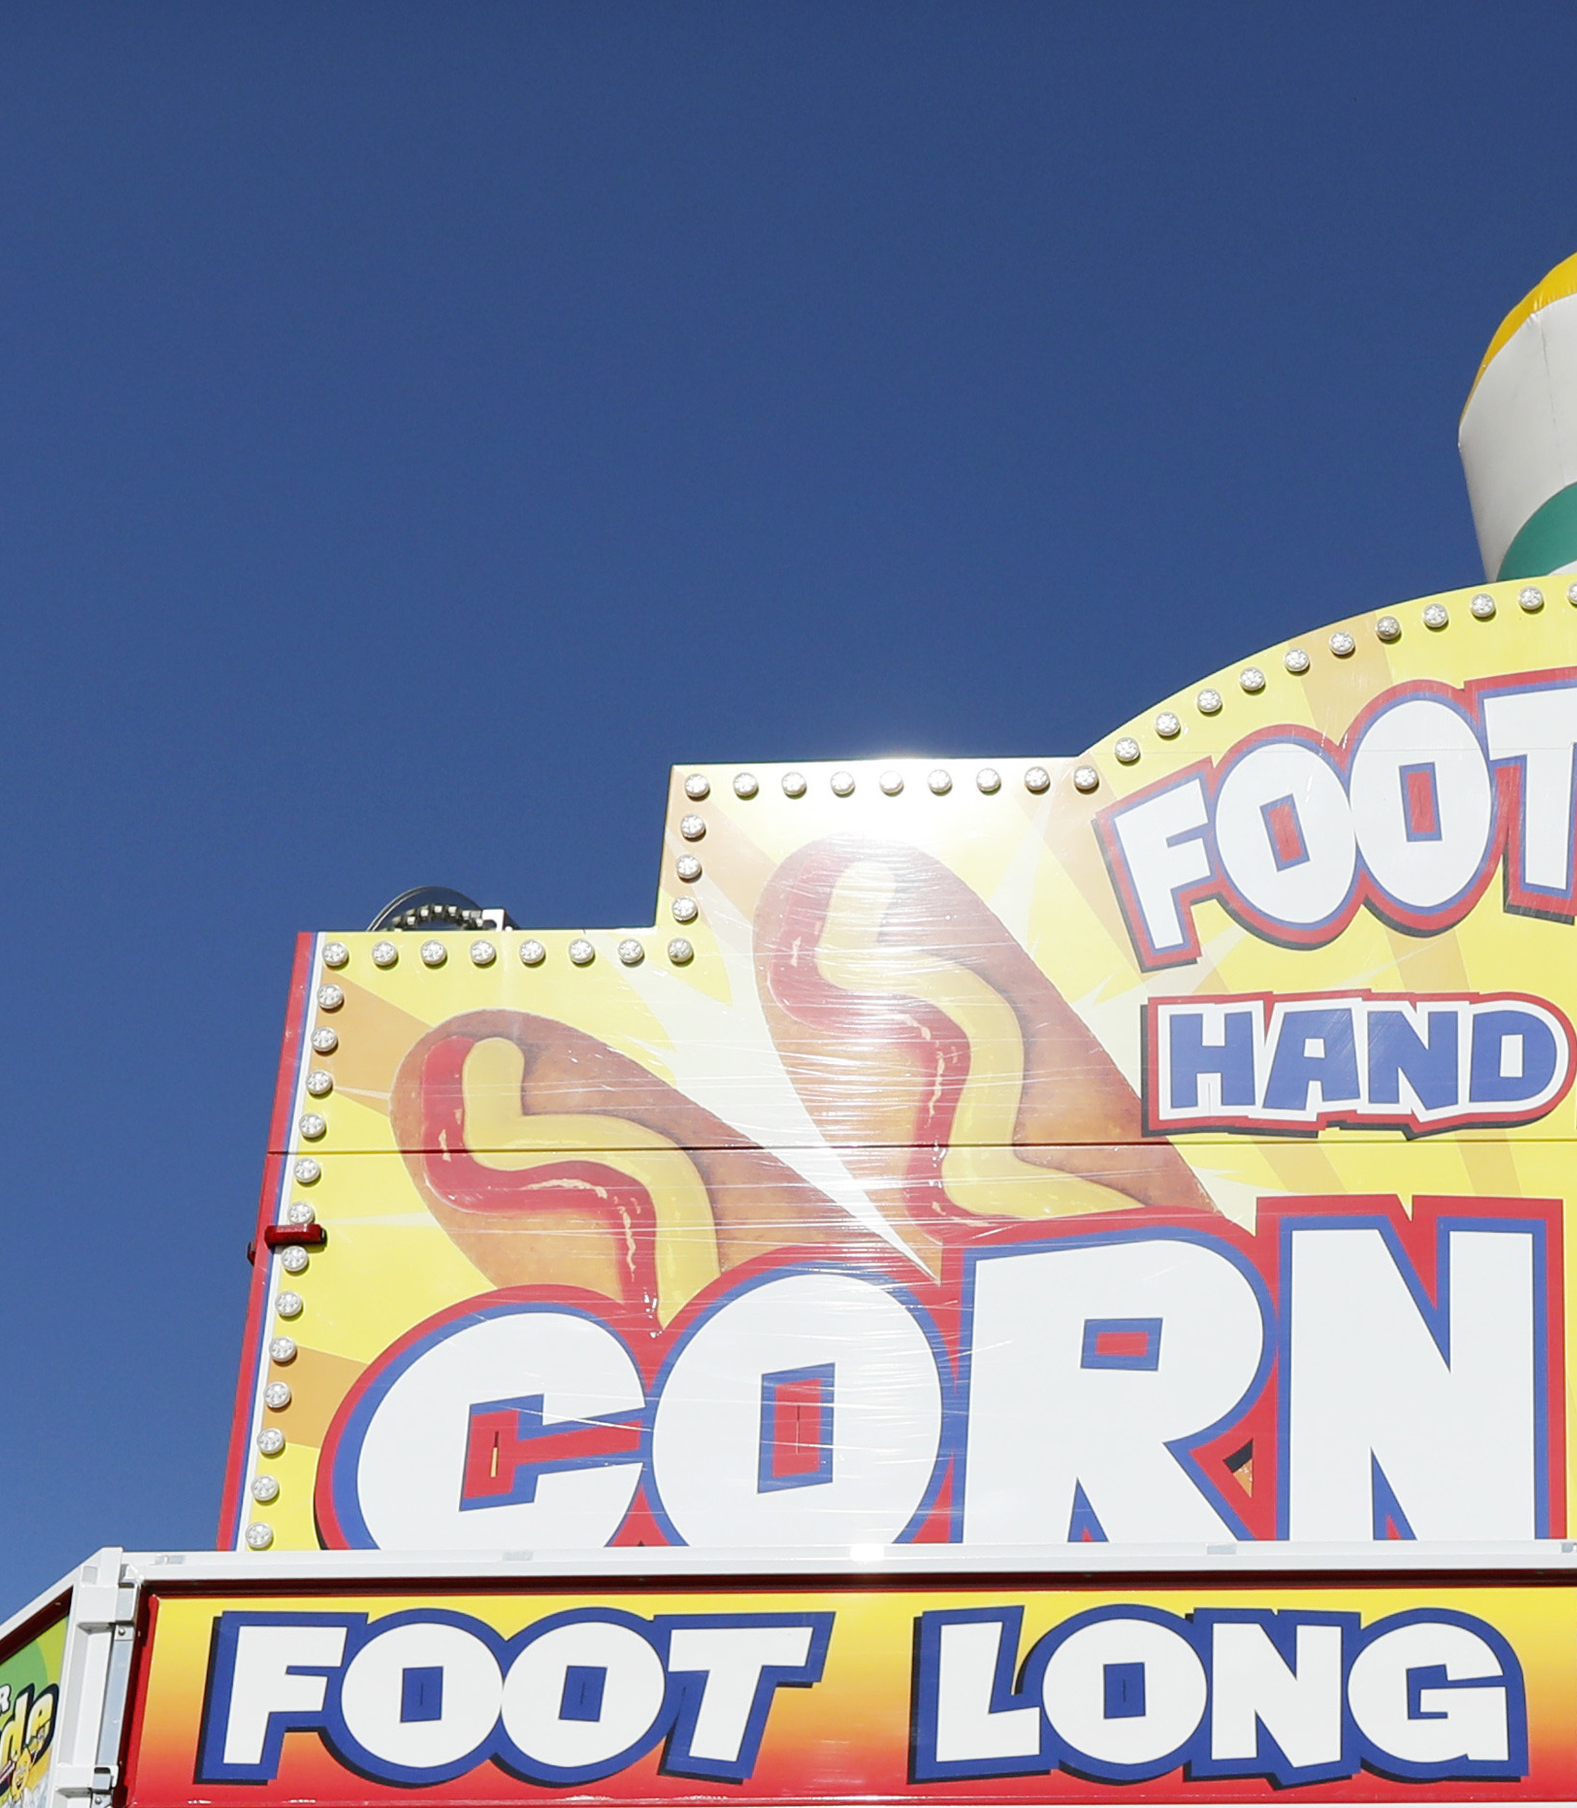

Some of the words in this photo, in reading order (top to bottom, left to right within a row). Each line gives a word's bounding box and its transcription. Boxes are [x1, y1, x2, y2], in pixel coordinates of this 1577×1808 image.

[1145, 992, 1577, 1133] HAND
[316, 1194, 1569, 1548] CORN
[196, 1606, 836, 1789] FOOT
[917, 1606, 1528, 1785] LONG
